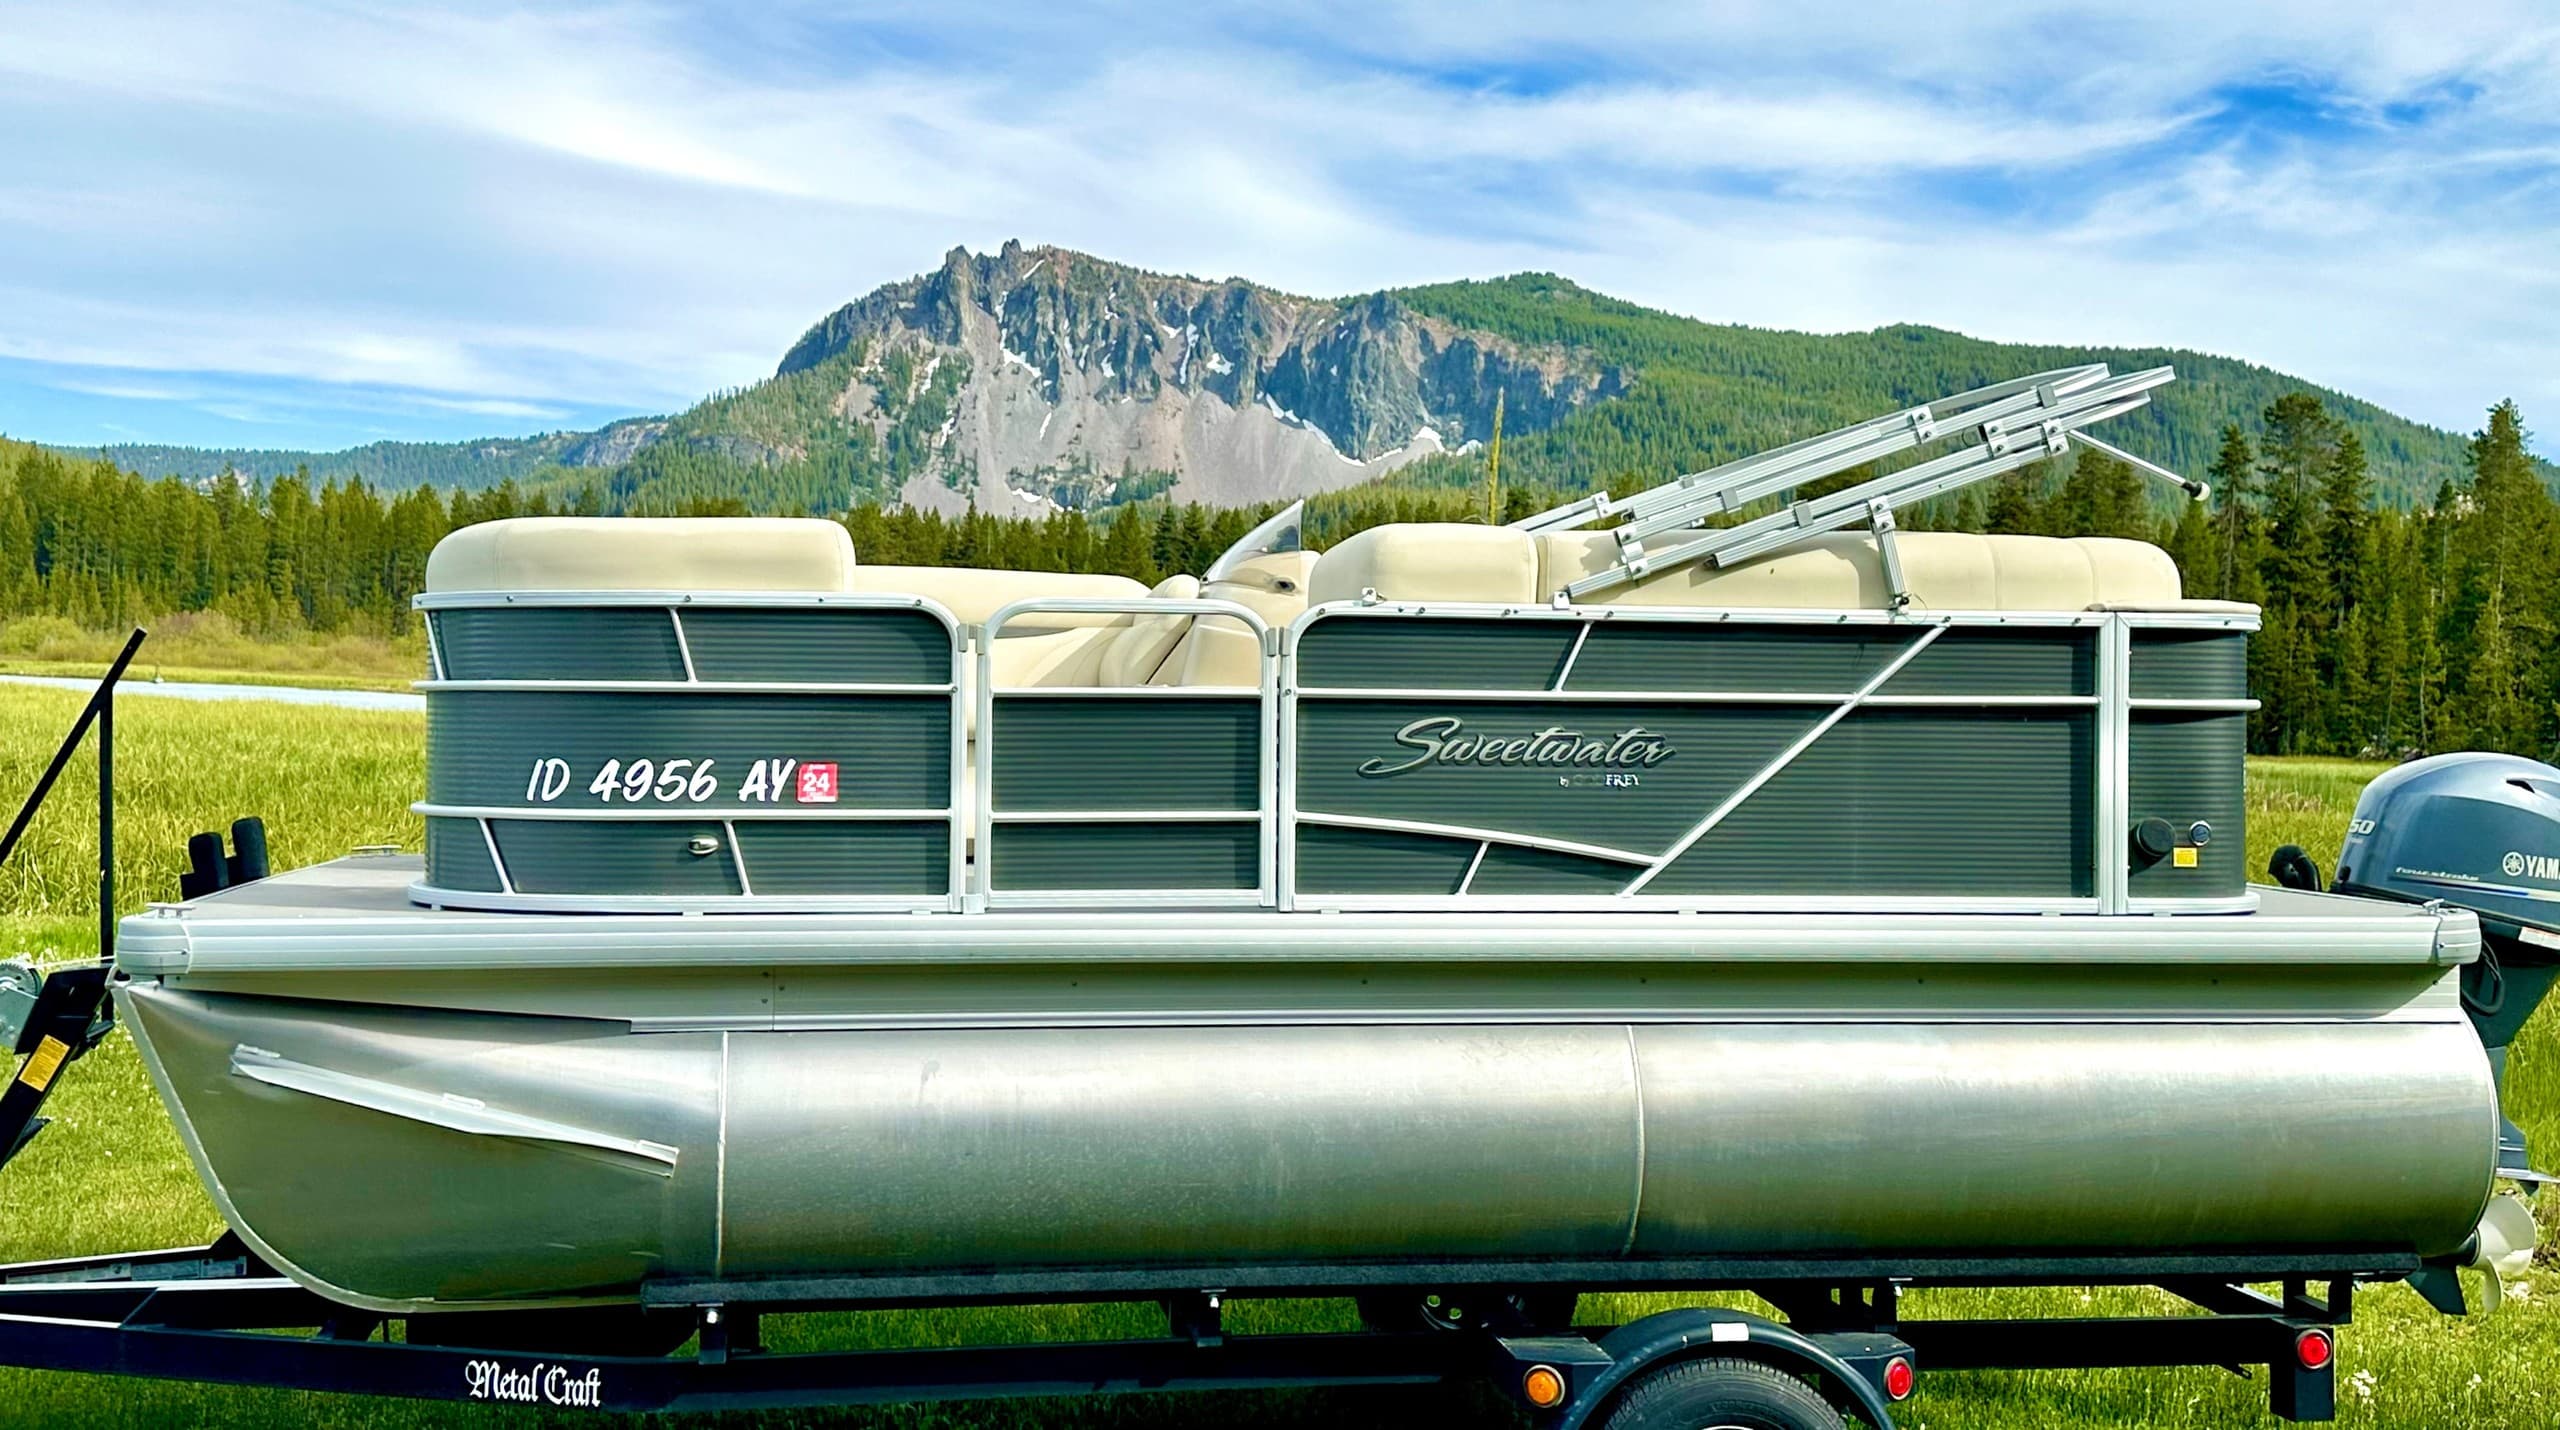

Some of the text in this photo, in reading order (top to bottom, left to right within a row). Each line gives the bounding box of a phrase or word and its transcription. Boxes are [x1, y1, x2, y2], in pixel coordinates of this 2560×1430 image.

[1357, 716, 1676, 777] Sweetwater
[526, 758, 796, 802] ID 4956 AY
[802, 772, 830, 792] 24
[2348, 819, 2376, 835] 50
[2526, 854, 2560, 880] YAM
[465, 1360, 601, 1407] Metal Craft
